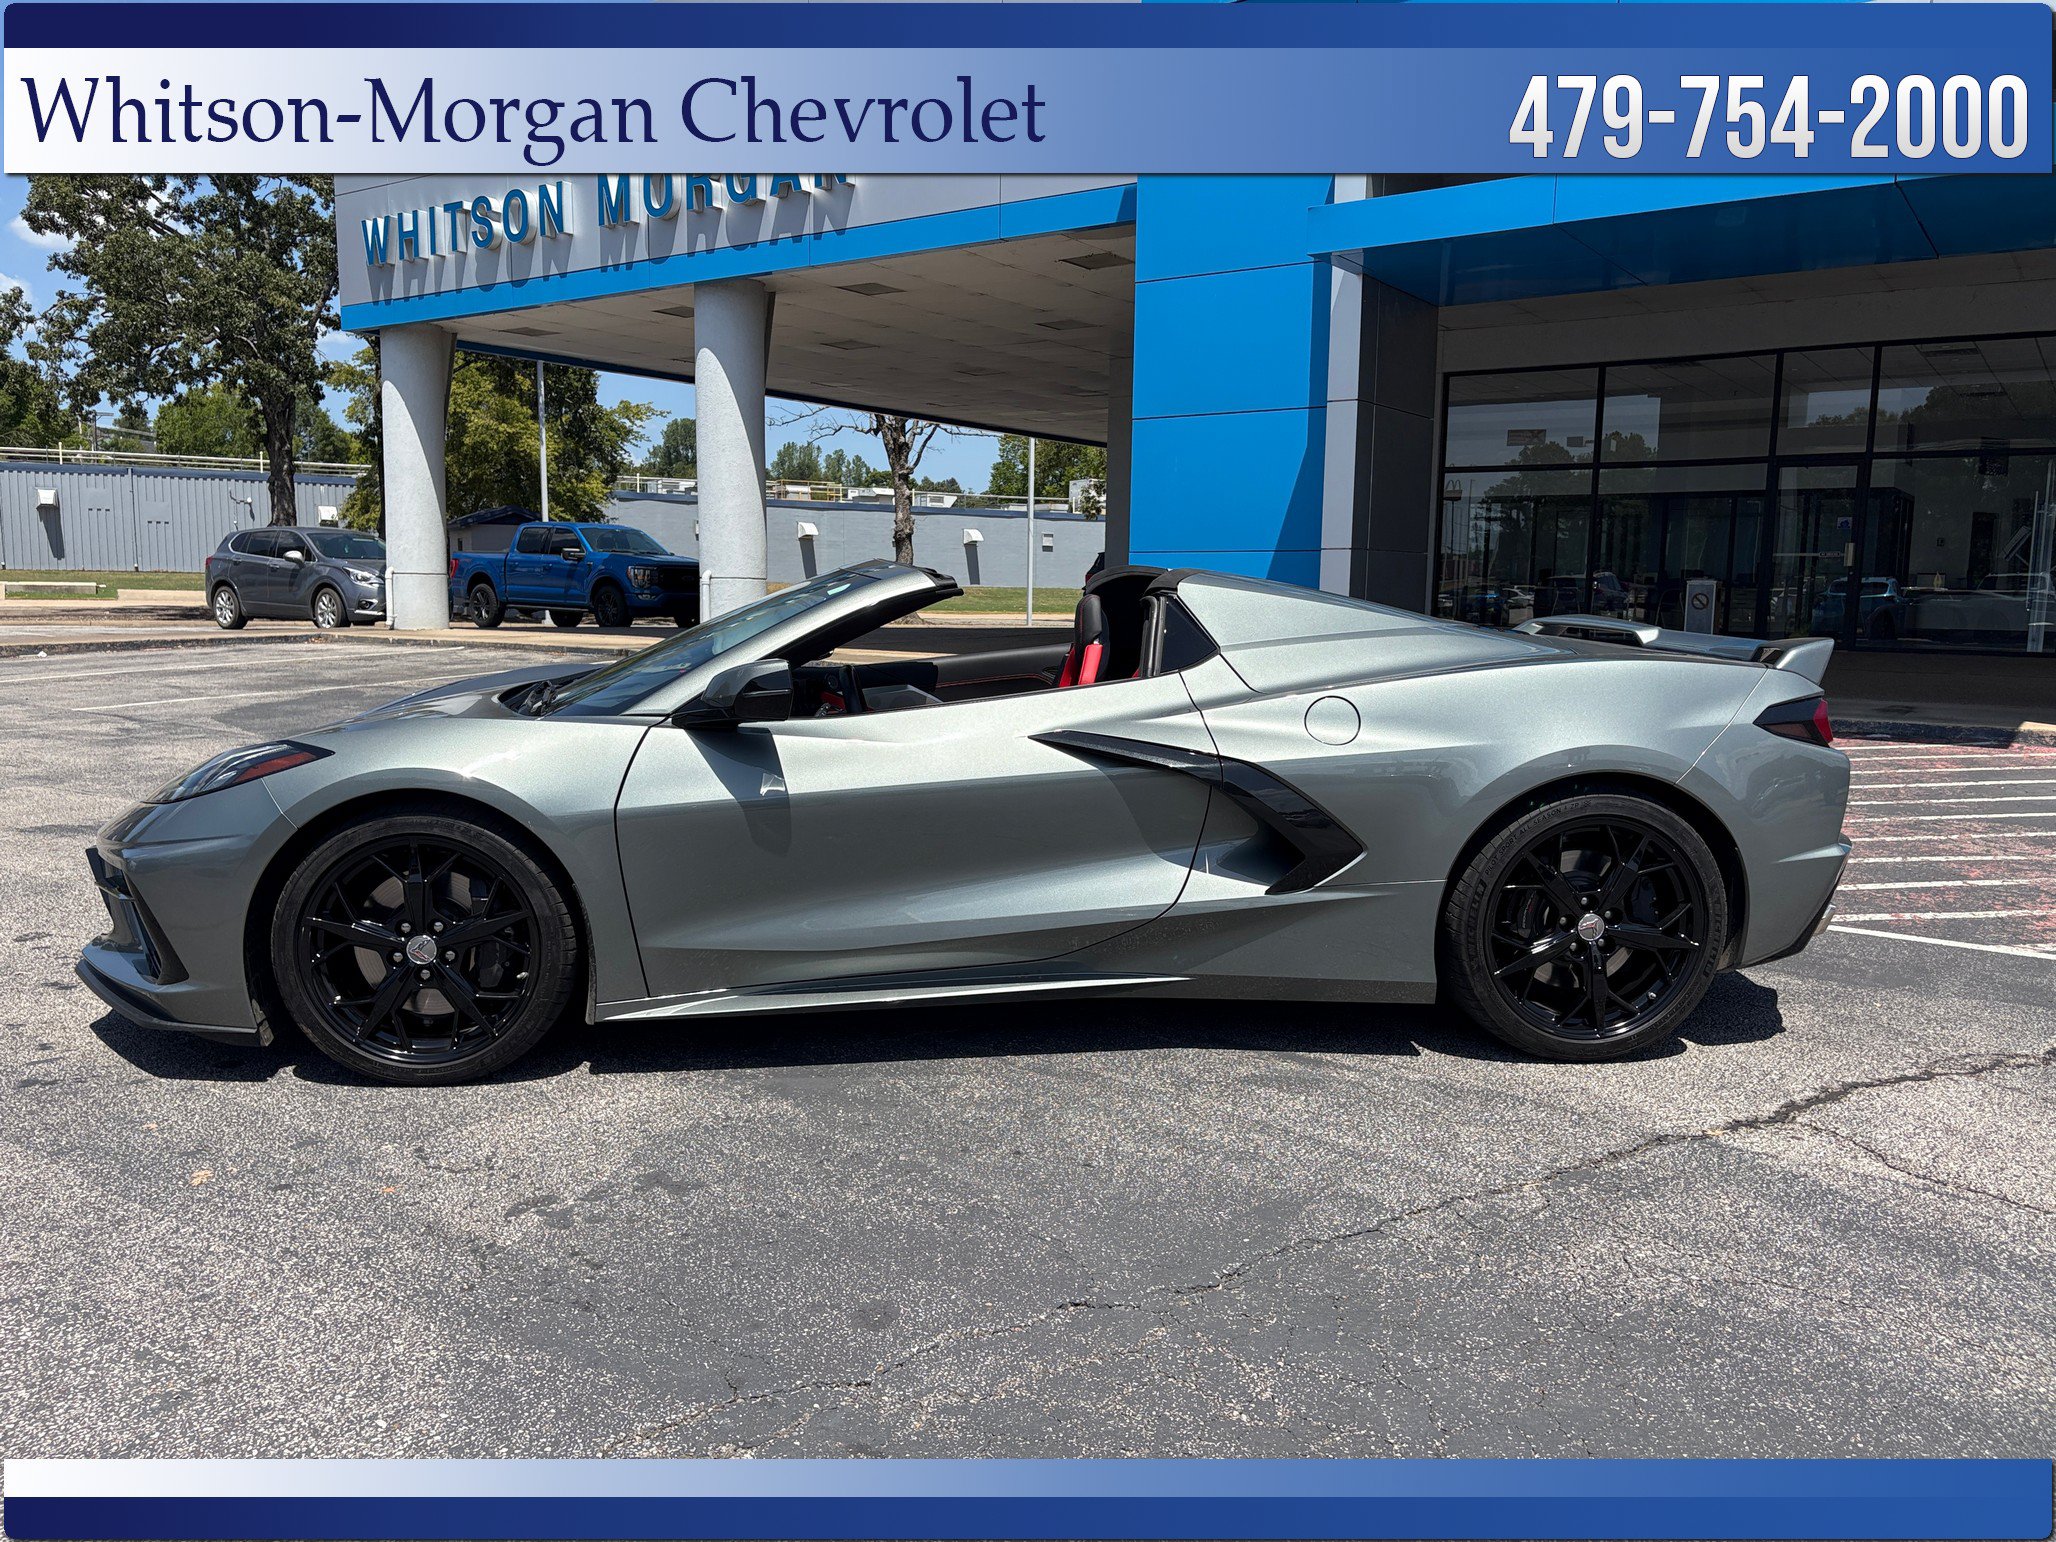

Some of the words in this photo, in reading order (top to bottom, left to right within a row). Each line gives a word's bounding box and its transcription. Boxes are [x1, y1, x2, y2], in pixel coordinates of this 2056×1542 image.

[361, 181, 568, 266] WHITSON
[597, 173, 850, 227] MOR
[1484, 857, 1499, 876] PILOT
[1498, 833, 1518, 856] SPORT
[1519, 824, 1532, 835] ALL
[1533, 807, 1562, 825] SEASON
